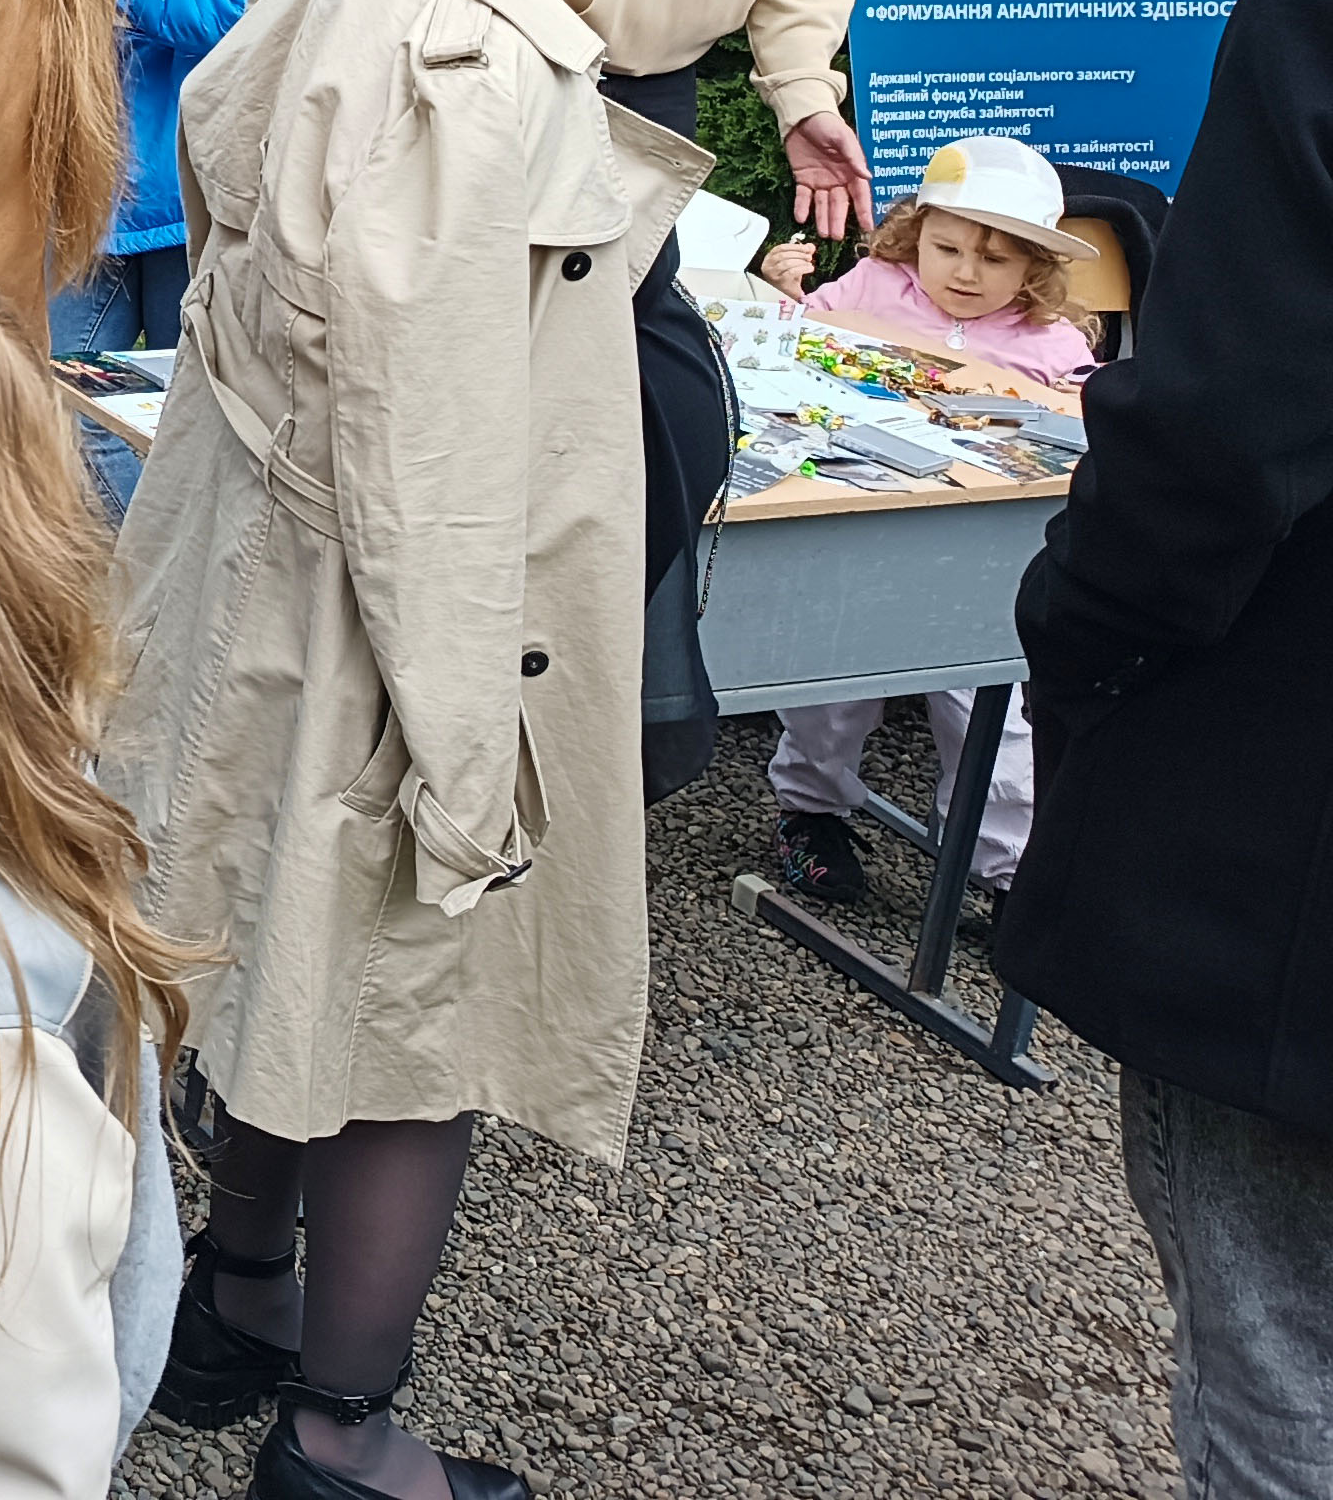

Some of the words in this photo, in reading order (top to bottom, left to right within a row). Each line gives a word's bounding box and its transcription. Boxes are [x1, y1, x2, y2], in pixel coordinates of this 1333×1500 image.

[875, 2, 992, 22] ФОРМУВАННЯ
[996, 1, 1137, 20] АНАЛІТИЧНИХ
[869, 71, 922, 87] Державні
[924, 71, 986, 87] установи
[988, 69, 1074, 85] соціального
[1076, 69, 1136, 84] захисту
[870, 88, 929, 104] Пенсійний
[931, 88, 967, 105] фонд
[969, 88, 1024, 103] України
[871, 108, 926, 125] Державна
[928, 107, 976, 123] служба
[978, 104, 1055, 119] зайнятості
[871, 127, 911, 143] Центри
[912, 125, 985, 141] соціальних
[988, 123, 1032, 138] служб
[873, 145, 909, 162] Агенції
[1072, 140, 1154, 154] зайнятості
[1119, 158, 1171, 173] фонди
